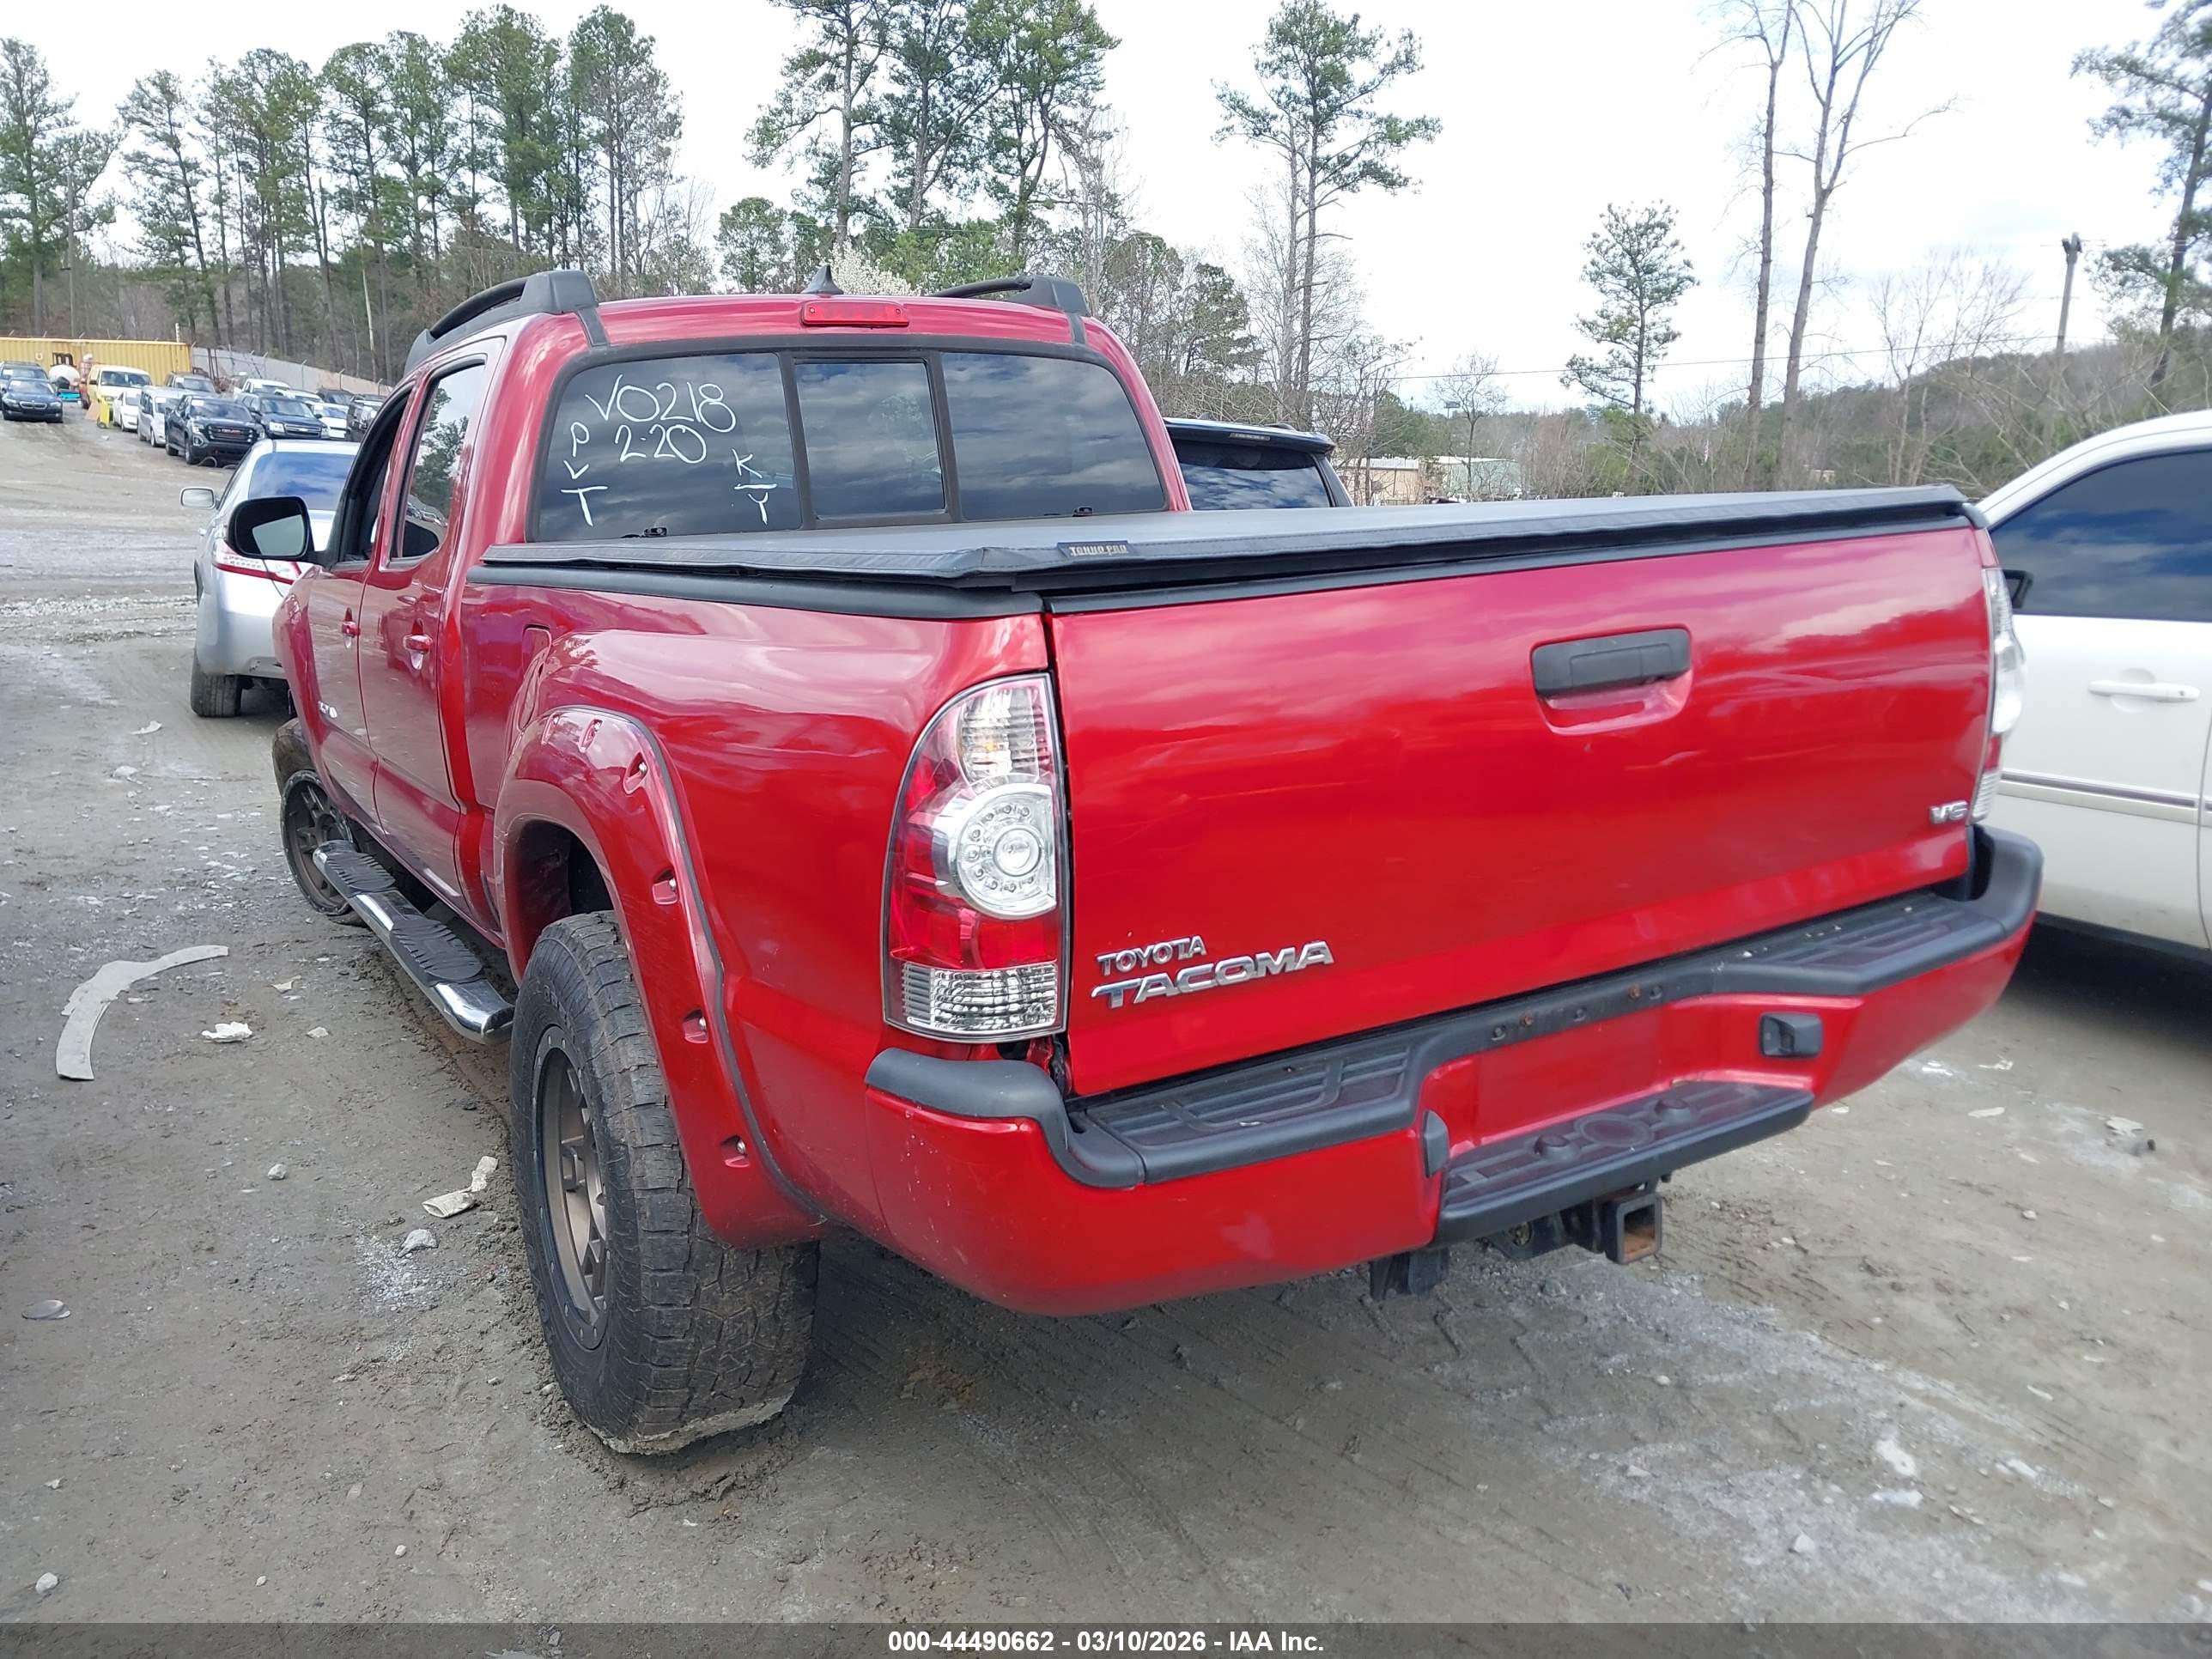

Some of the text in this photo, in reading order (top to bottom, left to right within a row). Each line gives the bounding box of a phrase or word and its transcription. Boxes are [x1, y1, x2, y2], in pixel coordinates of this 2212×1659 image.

[1929, 799, 1968, 824] V6
[1091, 940, 1335, 1009] TACOMA
[1097, 934, 1207, 976] TOYOTA
